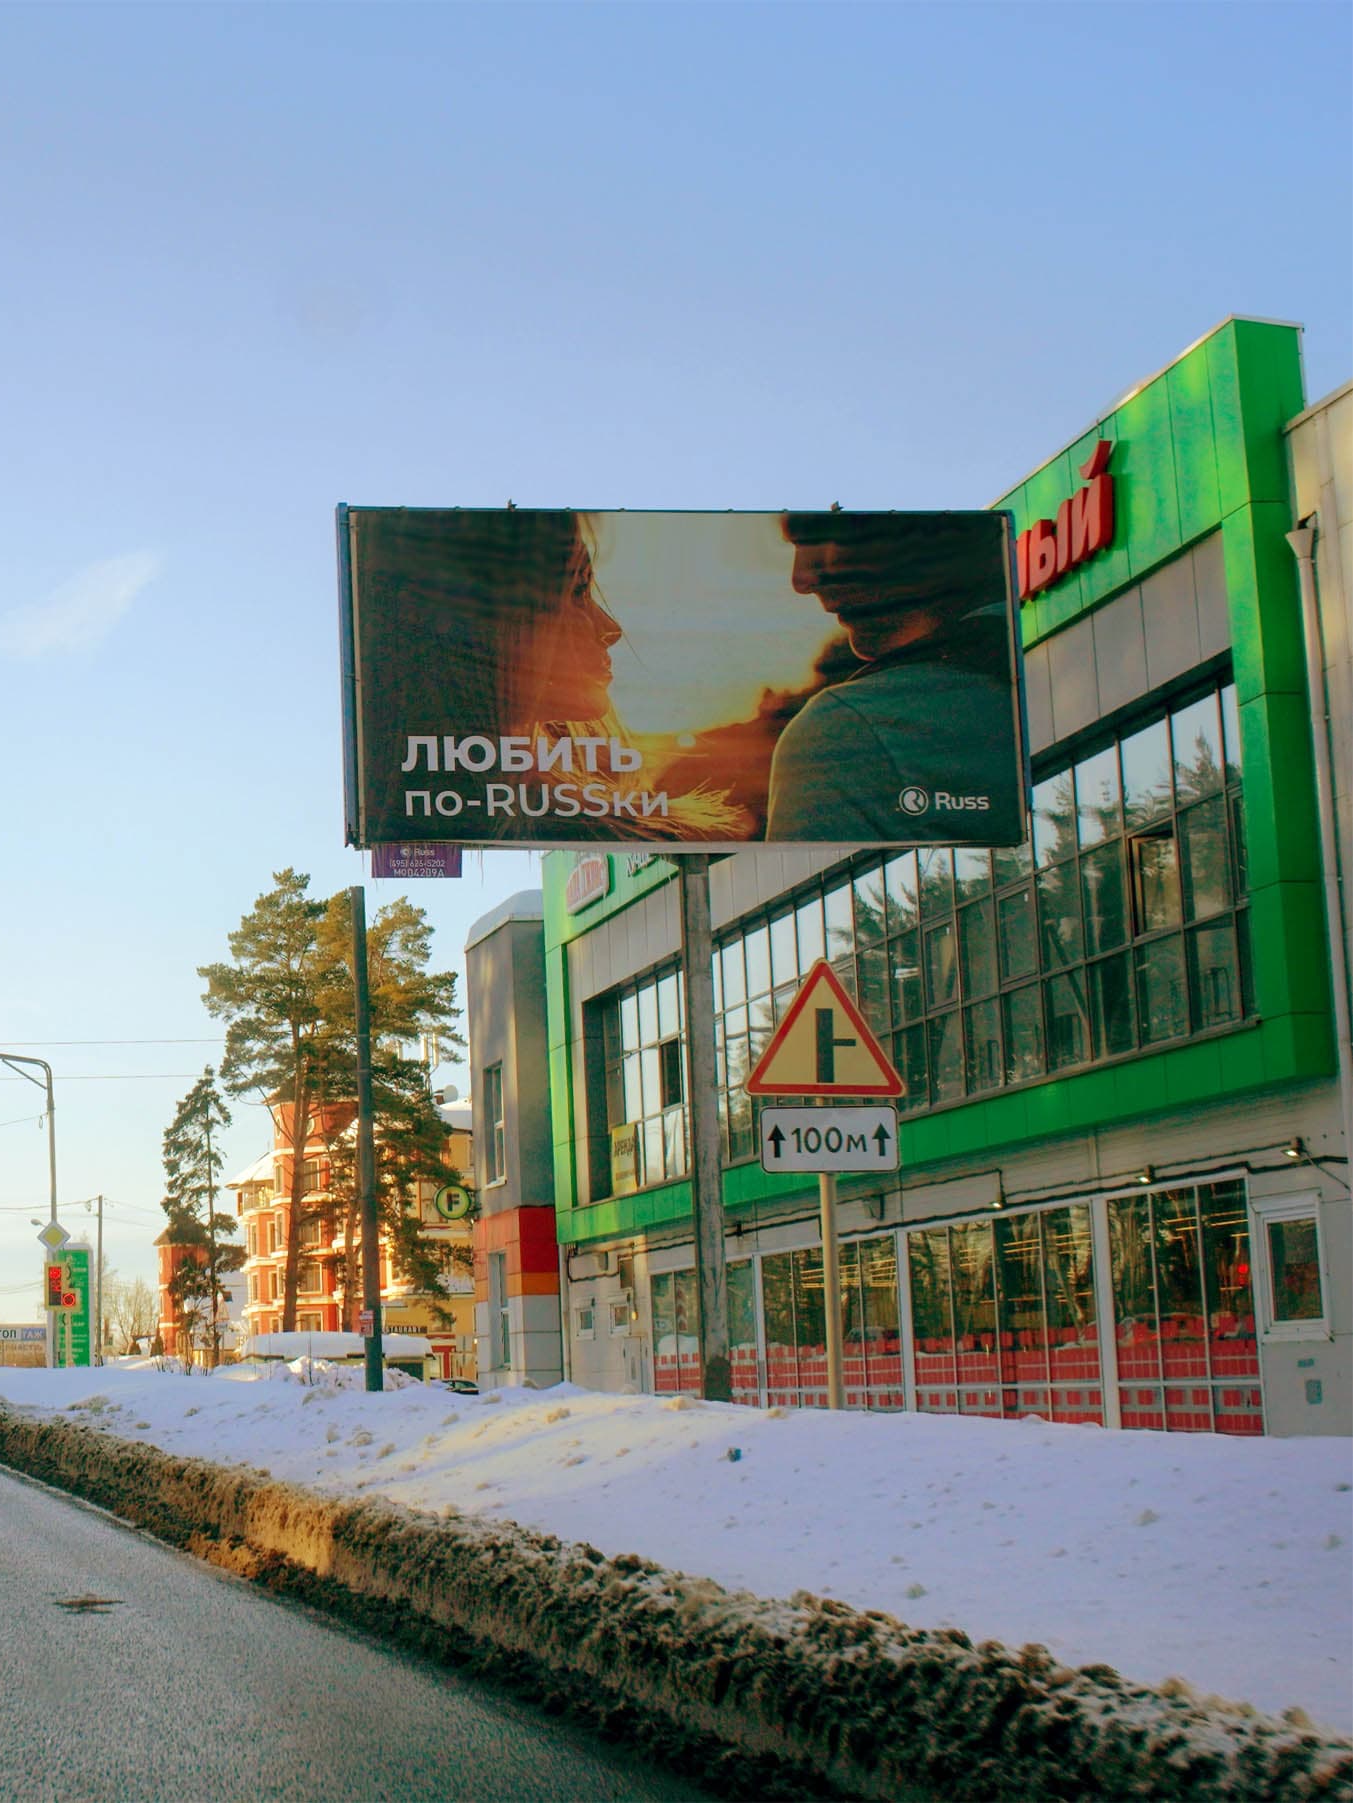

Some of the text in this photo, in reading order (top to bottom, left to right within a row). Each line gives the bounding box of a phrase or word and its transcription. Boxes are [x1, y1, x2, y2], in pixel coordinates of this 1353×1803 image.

[401, 735, 643, 773] ЛЮБИТЬ
[404, 783, 669, 817] по-RUSSки
[791, 1126, 867, 1154] 100м
